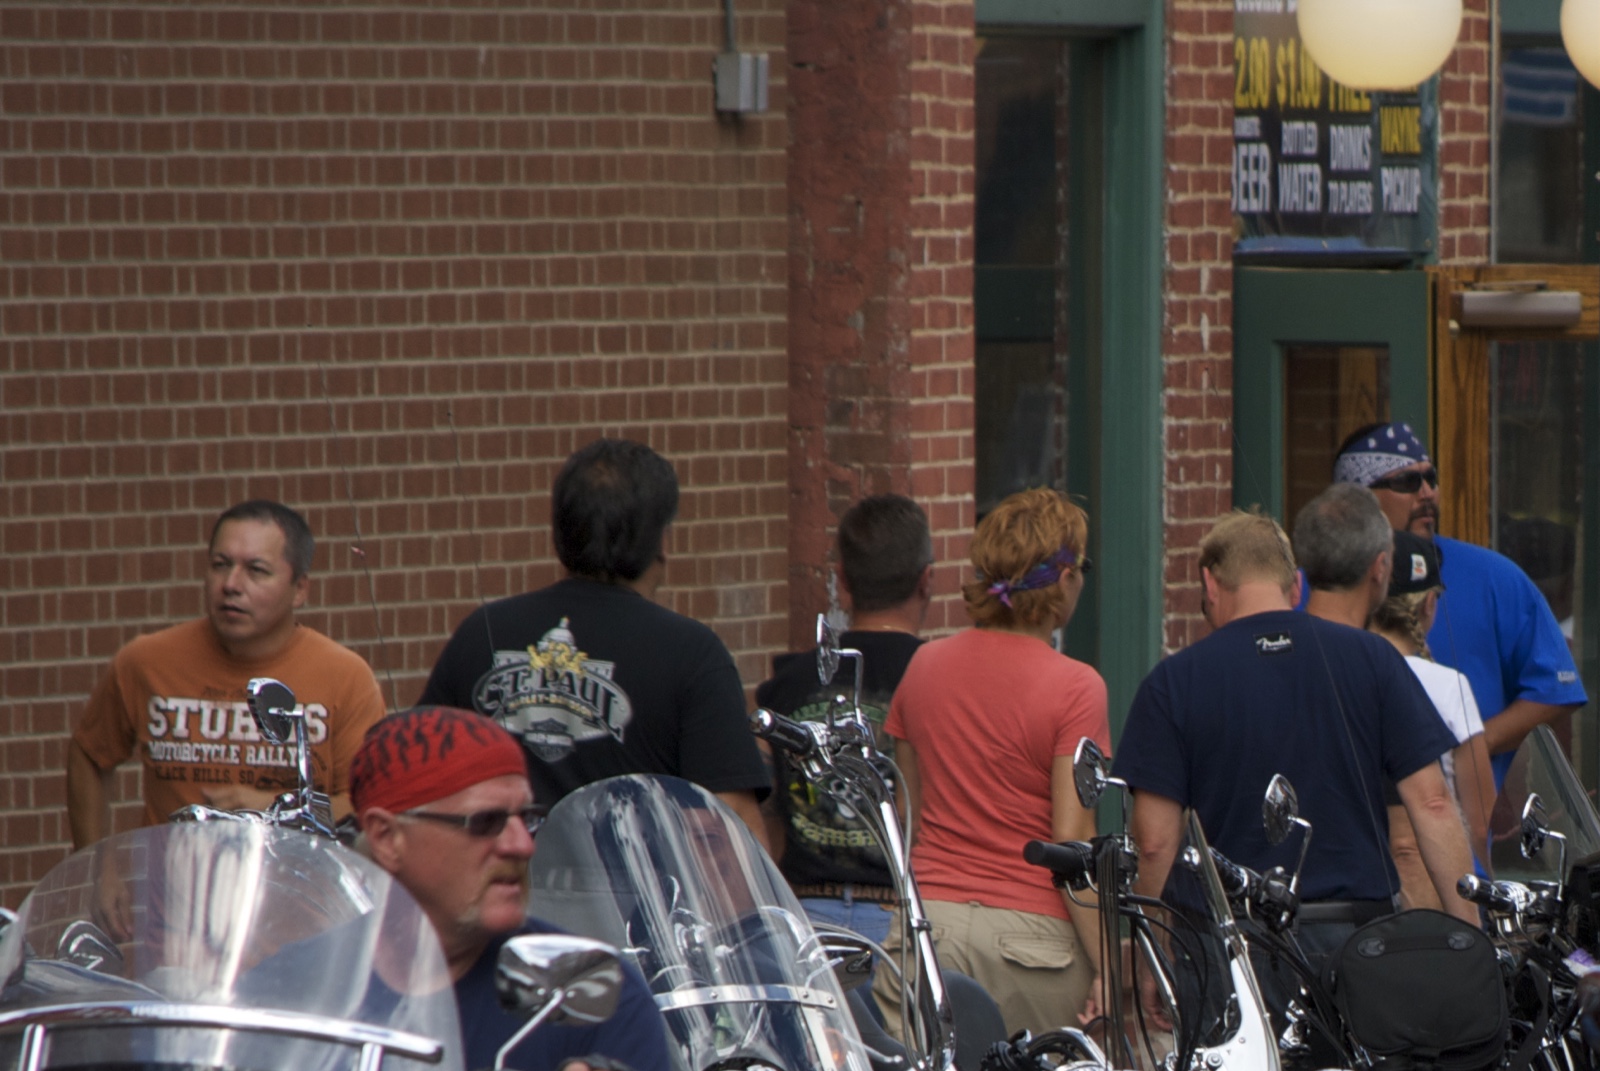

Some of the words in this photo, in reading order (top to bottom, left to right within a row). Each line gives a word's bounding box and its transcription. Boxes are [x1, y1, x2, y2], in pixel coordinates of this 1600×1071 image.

[1281, 121, 1319, 155] BOTTLED
[1329, 124, 1372, 170] DRINKS
[1278, 163, 1322, 212] WATER
[1328, 181, 1340, 213] TO
[1341, 181, 1373, 213] PLAYERS
[1380, 167, 1421, 213] PICKUP
[147, 697, 328, 744] STURS
[149, 741, 241, 765] MOTORCYCLE
[246, 746, 299, 767] RALLY
[239, 769, 255, 784] SD
